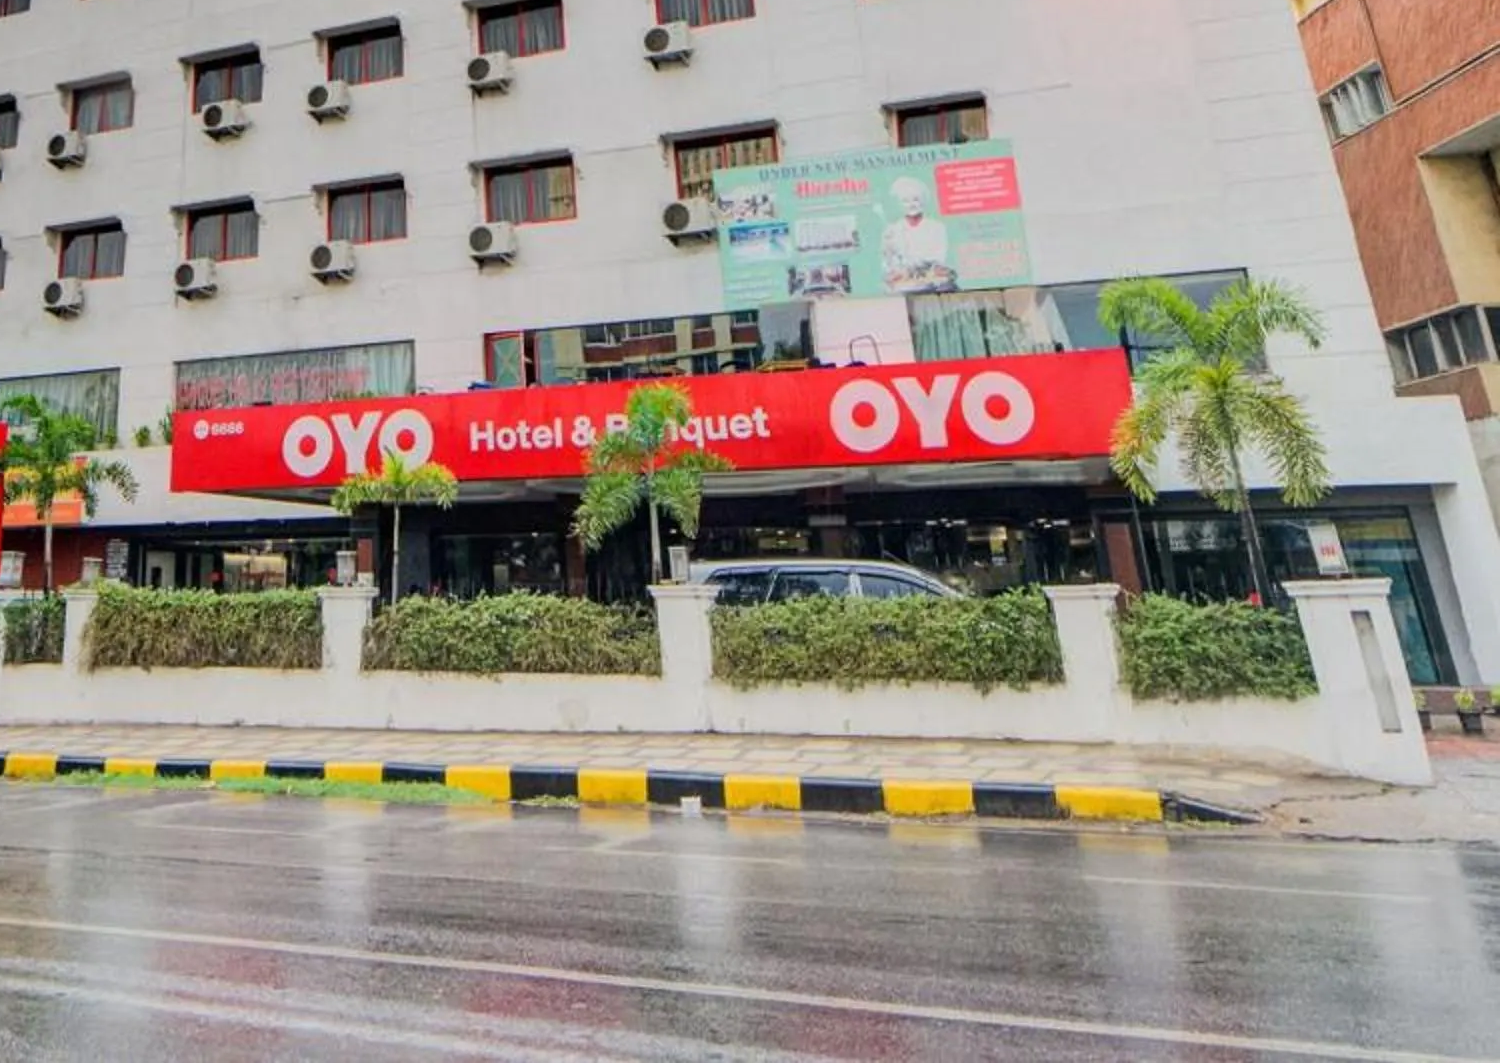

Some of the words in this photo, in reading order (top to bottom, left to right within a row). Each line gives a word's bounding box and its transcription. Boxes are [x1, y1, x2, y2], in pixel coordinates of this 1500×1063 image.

[759, 165, 809, 182] UNDER
[814, 159, 846, 174] NEW
[852, 147, 960, 171] MANAGEMENT
[468, 417, 563, 452] Hotel
[572, 415, 597, 444] &
[605, 407, 772, 450] Bnquet
[829, 371, 1036, 453] OYO
[282, 408, 434, 478] OYO
